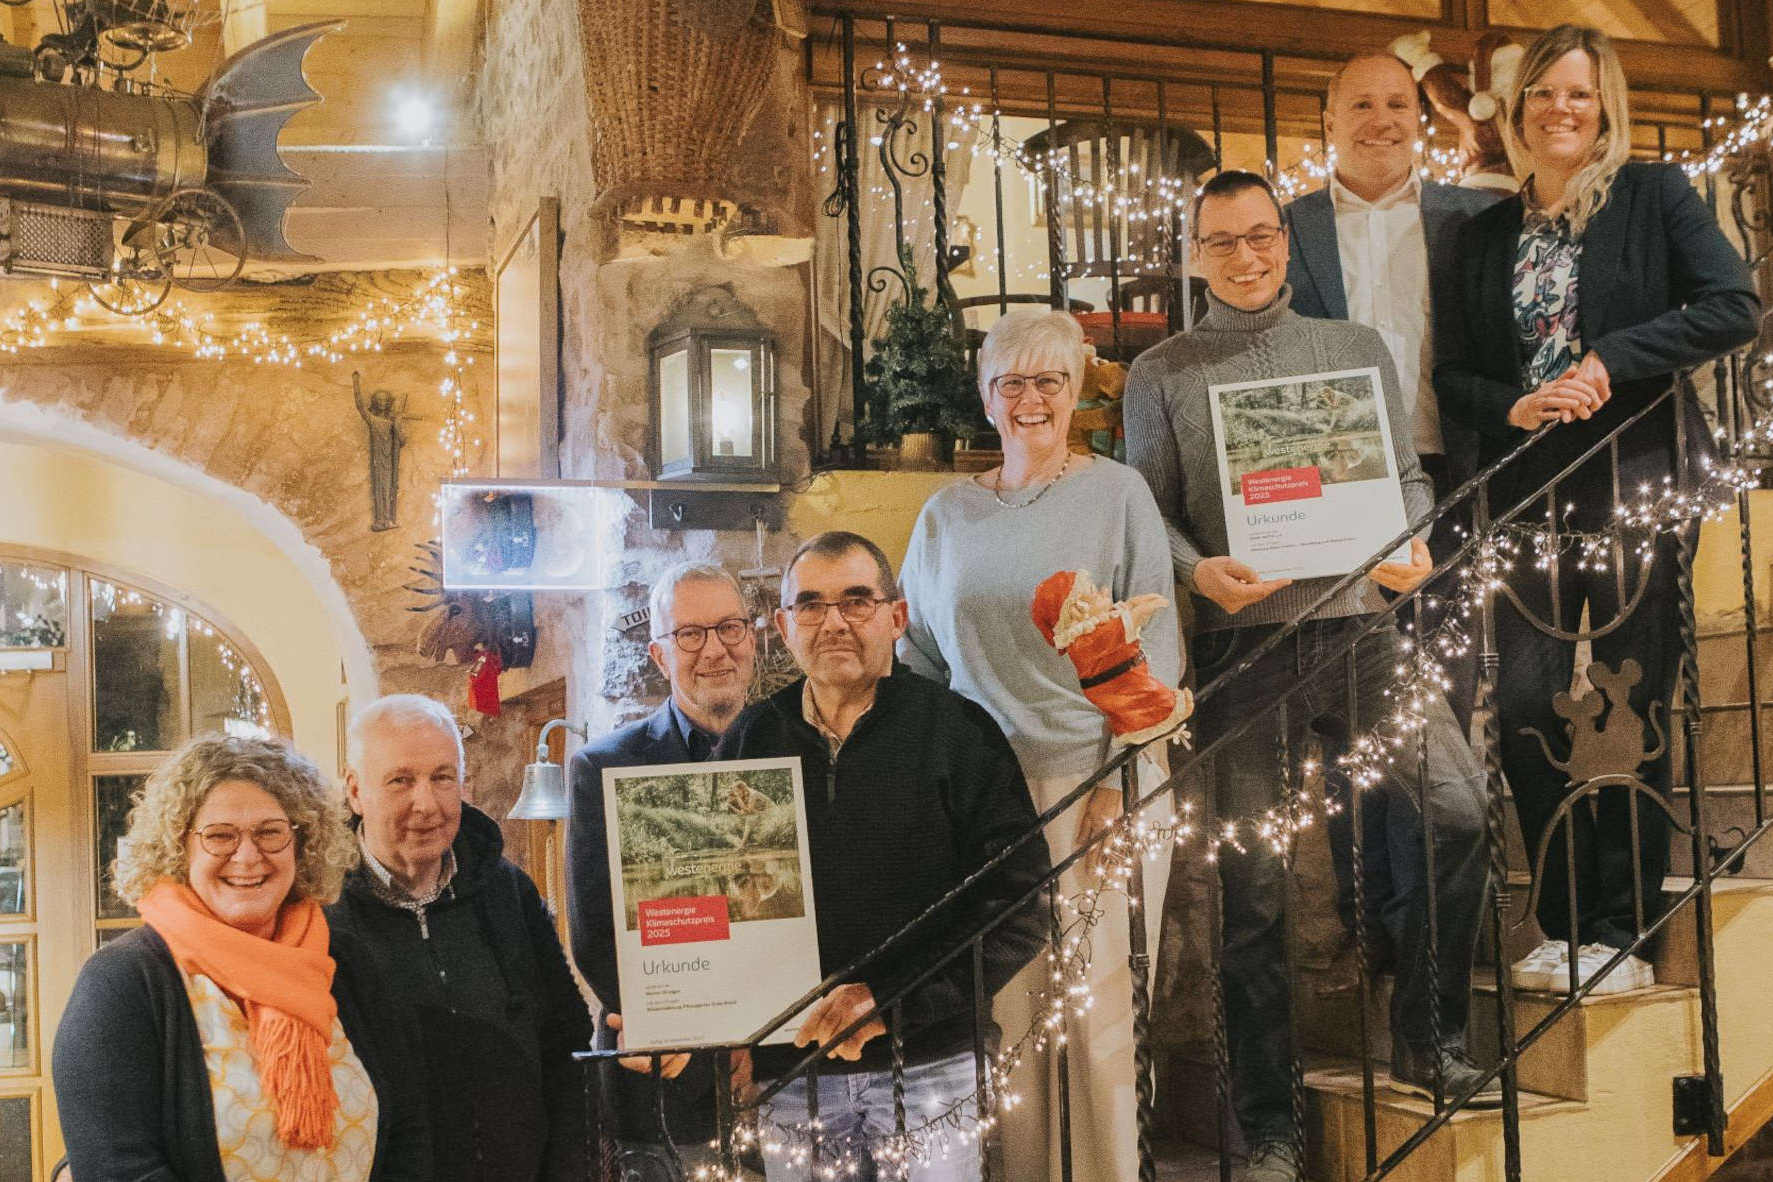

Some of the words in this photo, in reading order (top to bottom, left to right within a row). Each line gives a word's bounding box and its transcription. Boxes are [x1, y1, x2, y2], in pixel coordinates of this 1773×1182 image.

[1247, 475, 1292, 485] Westenergie
[1249, 492, 1270, 500] 2025
[1246, 511, 1306, 526] Urkunde
[667, 862, 742, 876] westenergie
[645, 906, 696, 917] Westenergie
[646, 915, 715, 928] Klimaschutzpreis
[647, 929, 670, 939] 2025
[643, 957, 711, 976] Urkunde
